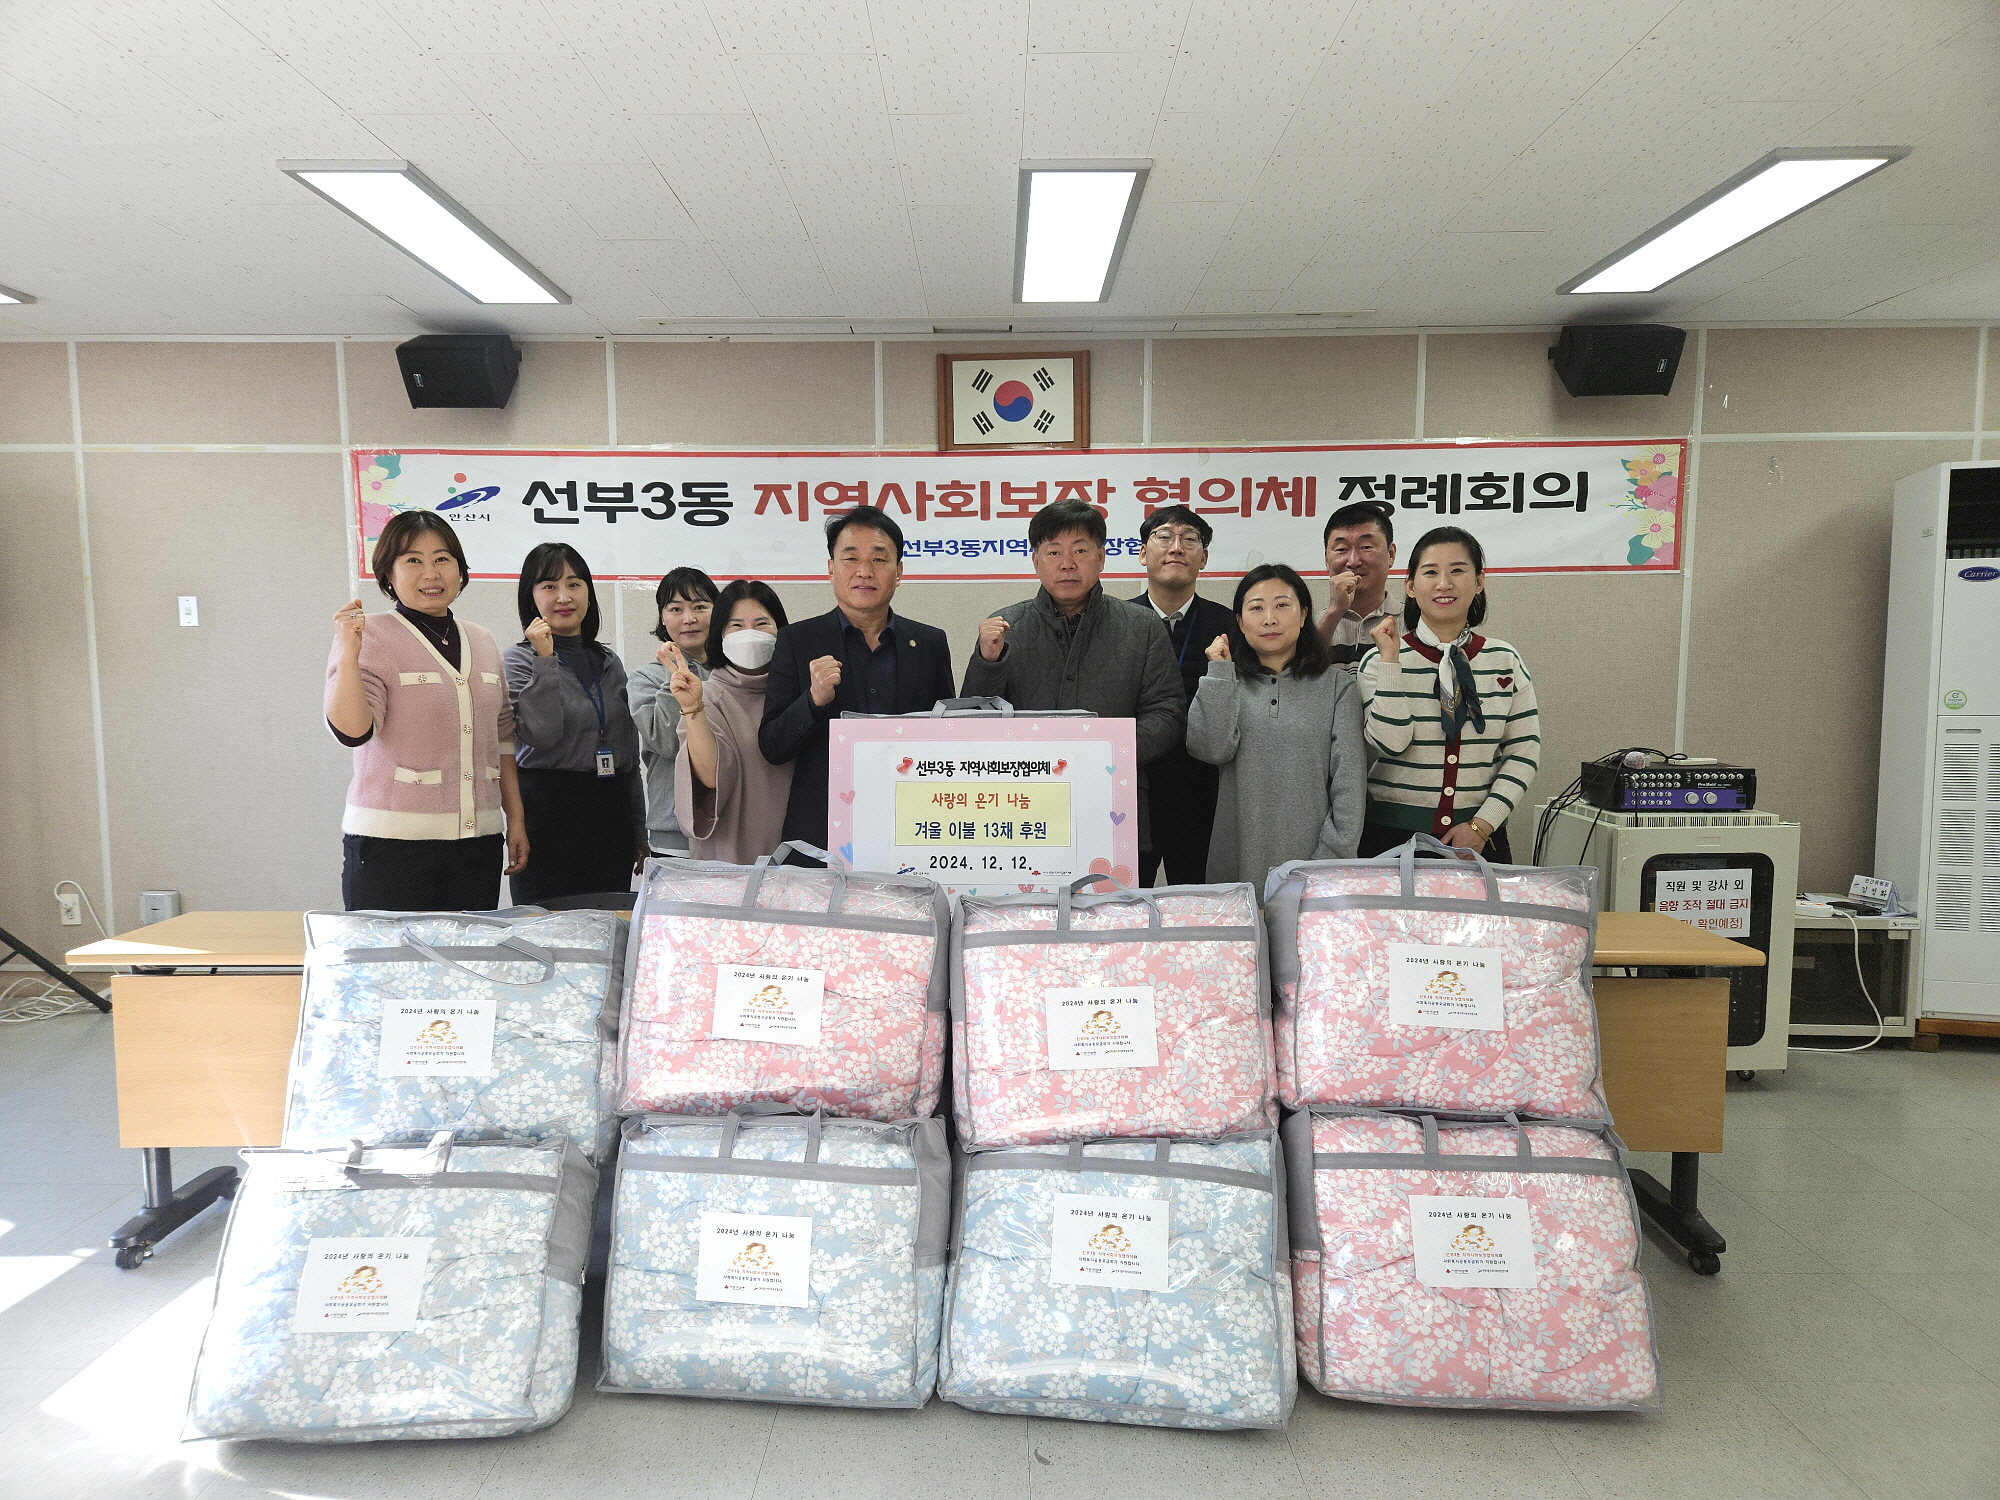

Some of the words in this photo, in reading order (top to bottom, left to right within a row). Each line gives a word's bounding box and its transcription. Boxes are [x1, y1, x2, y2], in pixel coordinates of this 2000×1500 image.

[520, 480, 734, 527] 선부3동
[753, 478, 1116, 521] 지역사회보장
[1133, 474, 1317, 520] 협의체
[1338, 471, 1589, 518] 정례회의
[449, 513, 490, 521] 안산시
[1964, 570, 1998, 578] Carrier
[916, 760, 955, 777] 선부3동
[960, 760, 1050, 777] 지역사회보장협의체
[931, 793, 967, 810] 사랑의
[975, 793, 999, 810] 온기
[1007, 793, 1031, 810] 나눔
[915, 821, 942, 840] 겨울
[949, 821, 976, 840] 이불
[983, 821, 1013, 840] 13채
[1020, 821, 1047, 840] 후원
[930, 855, 973, 871] 2024.
[981, 855, 1003, 871] 12.
[1011, 855, 1033, 871] 12.
[1665, 880, 1686, 892] 직원
[1692, 880, 1702, 891] 및
[1707, 879, 1728, 891] 강사
[1733, 879, 1744, 890] 외
[1659, 900, 1679, 911] 음향
[1682, 899, 1702, 910] 조작
[1706, 899, 1725, 910] 절대
[1730, 898, 1748, 909] 금지
[1070, 1209, 1094, 1217] 2024년
[1428, 1211, 1453, 1219] 2024년
[716, 1228, 739, 1236] 2024년
